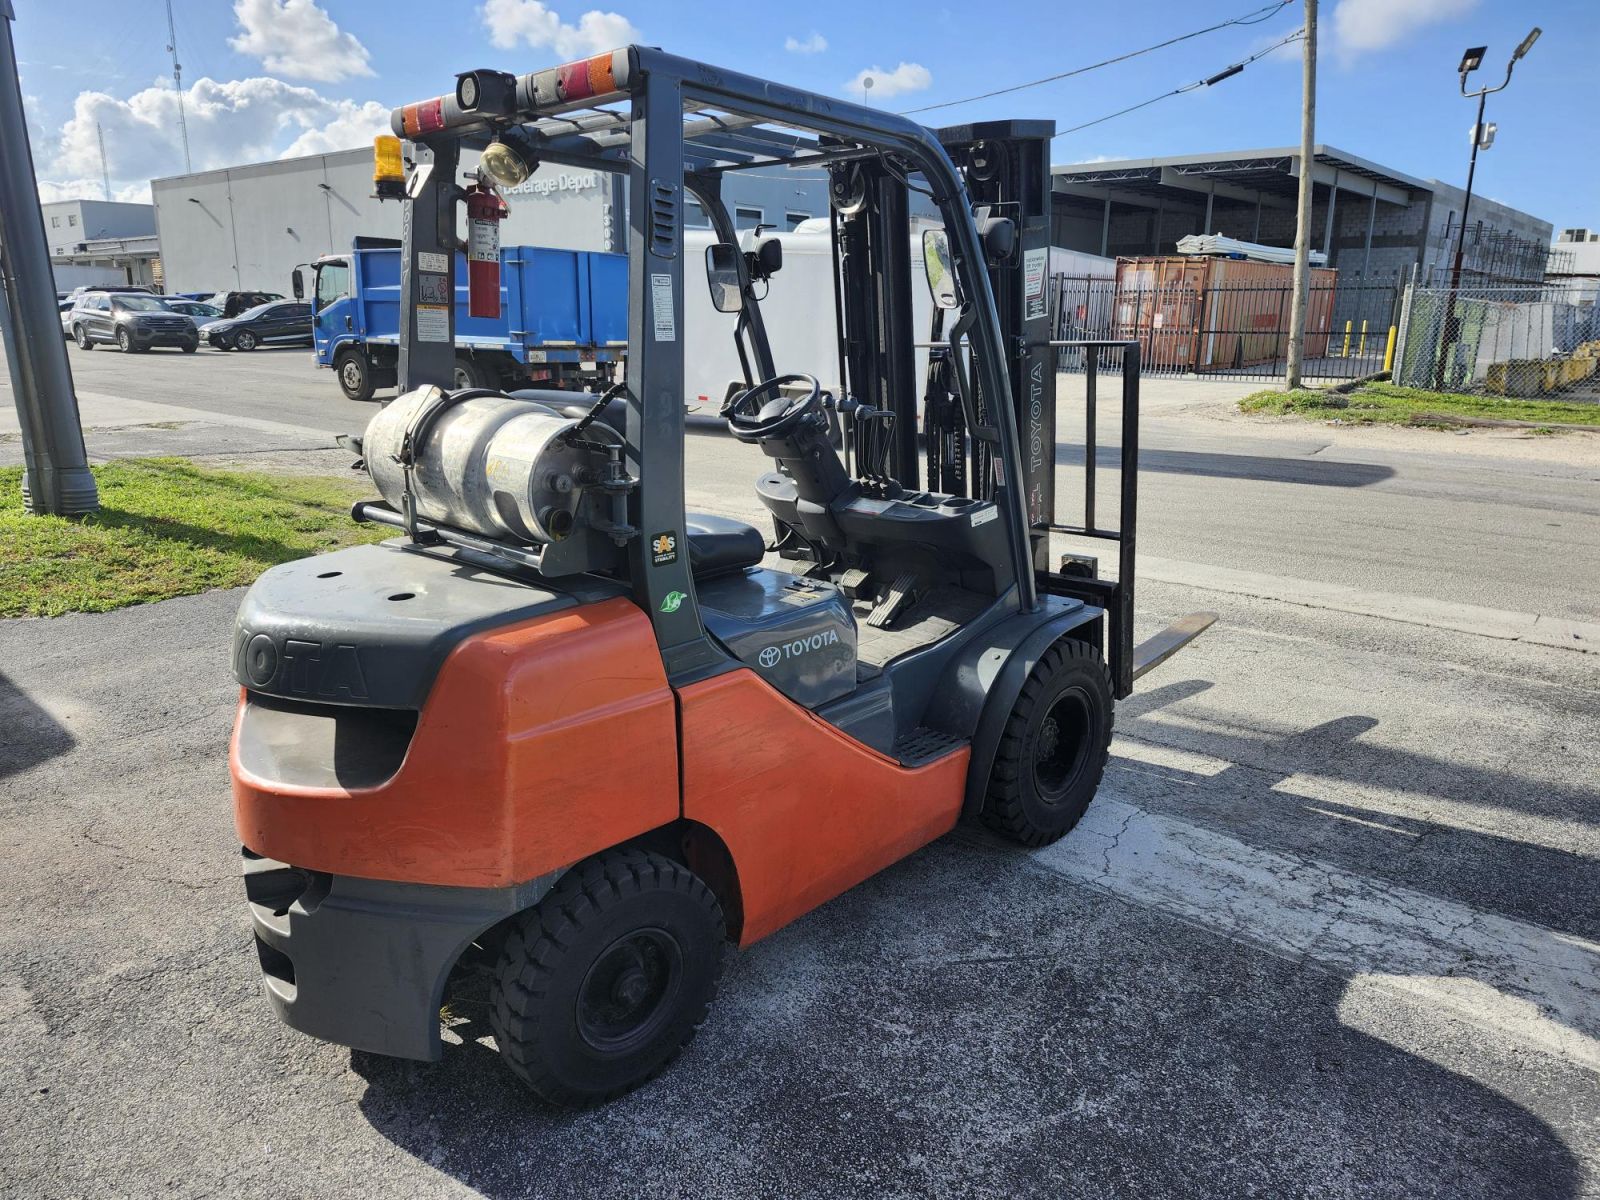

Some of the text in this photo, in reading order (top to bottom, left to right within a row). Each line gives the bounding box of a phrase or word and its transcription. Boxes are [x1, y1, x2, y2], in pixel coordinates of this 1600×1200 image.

[559, 173, 597, 193] Depot
[1031, 362, 1042, 473] TOYOTA
[653, 535, 676, 553] SAS
[783, 629, 838, 659] TOYOTA
